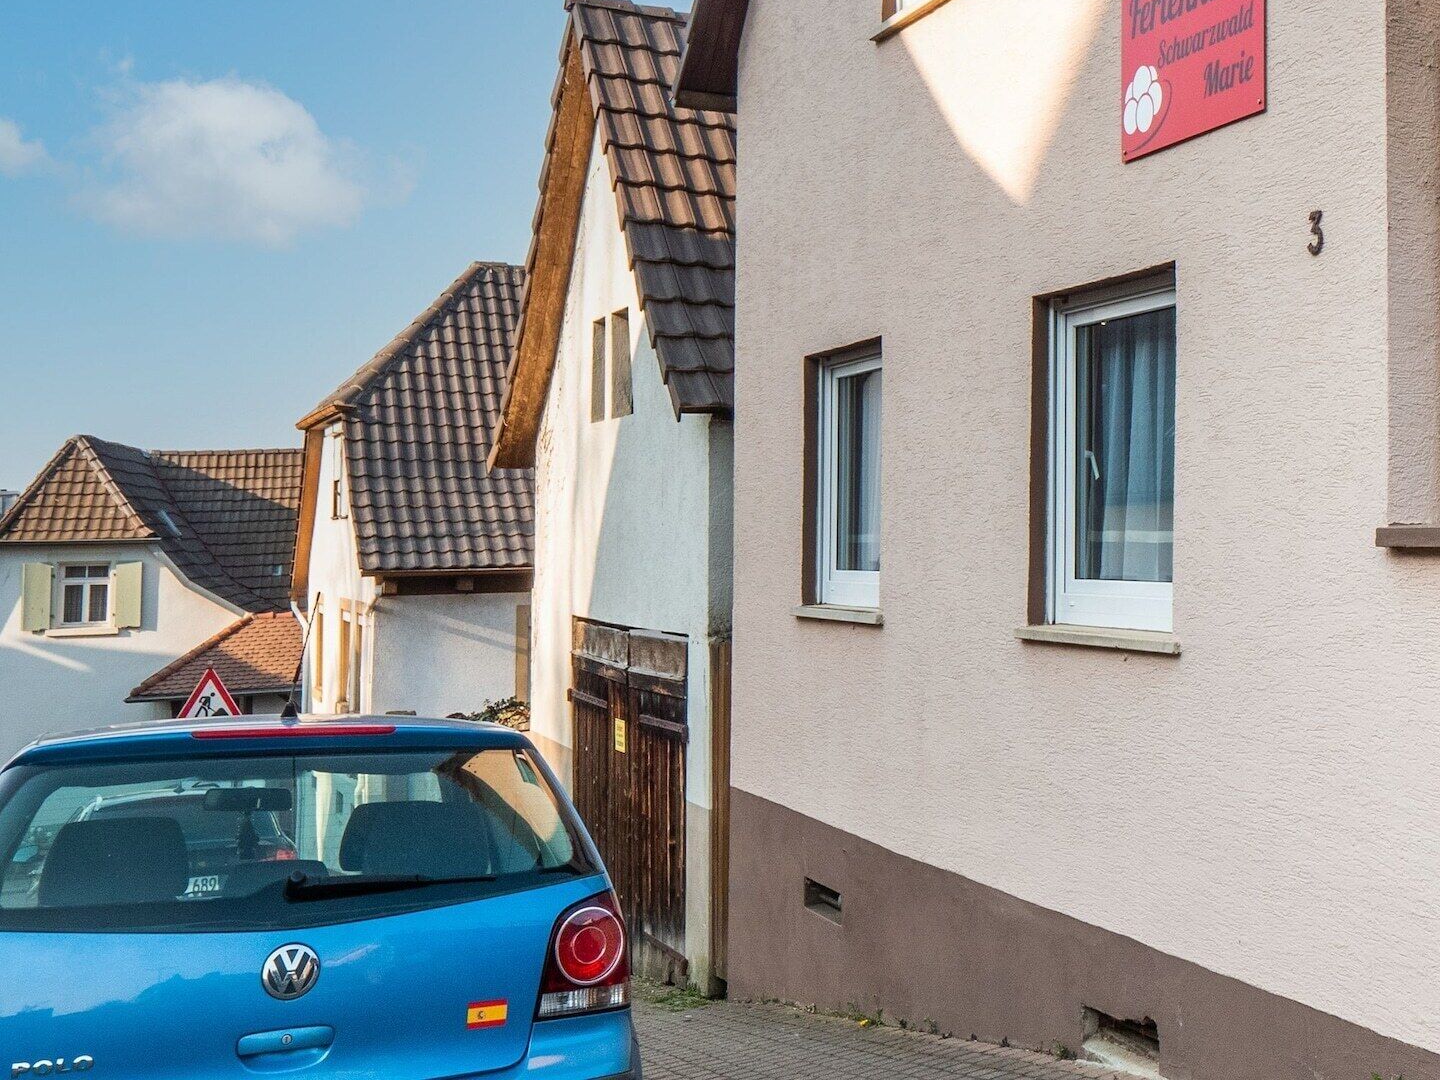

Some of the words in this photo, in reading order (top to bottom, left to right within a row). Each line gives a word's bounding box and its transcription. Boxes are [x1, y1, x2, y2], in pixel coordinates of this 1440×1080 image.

[1157, 1, 1254, 69] Schwarzwald
[1204, 51, 1254, 98] Marie
[1307, 210, 1323, 256] 3
[193, 877, 217, 892] 689
[261, 942, 321, 1000] VW
[11, 1055, 94, 1080] POLO
